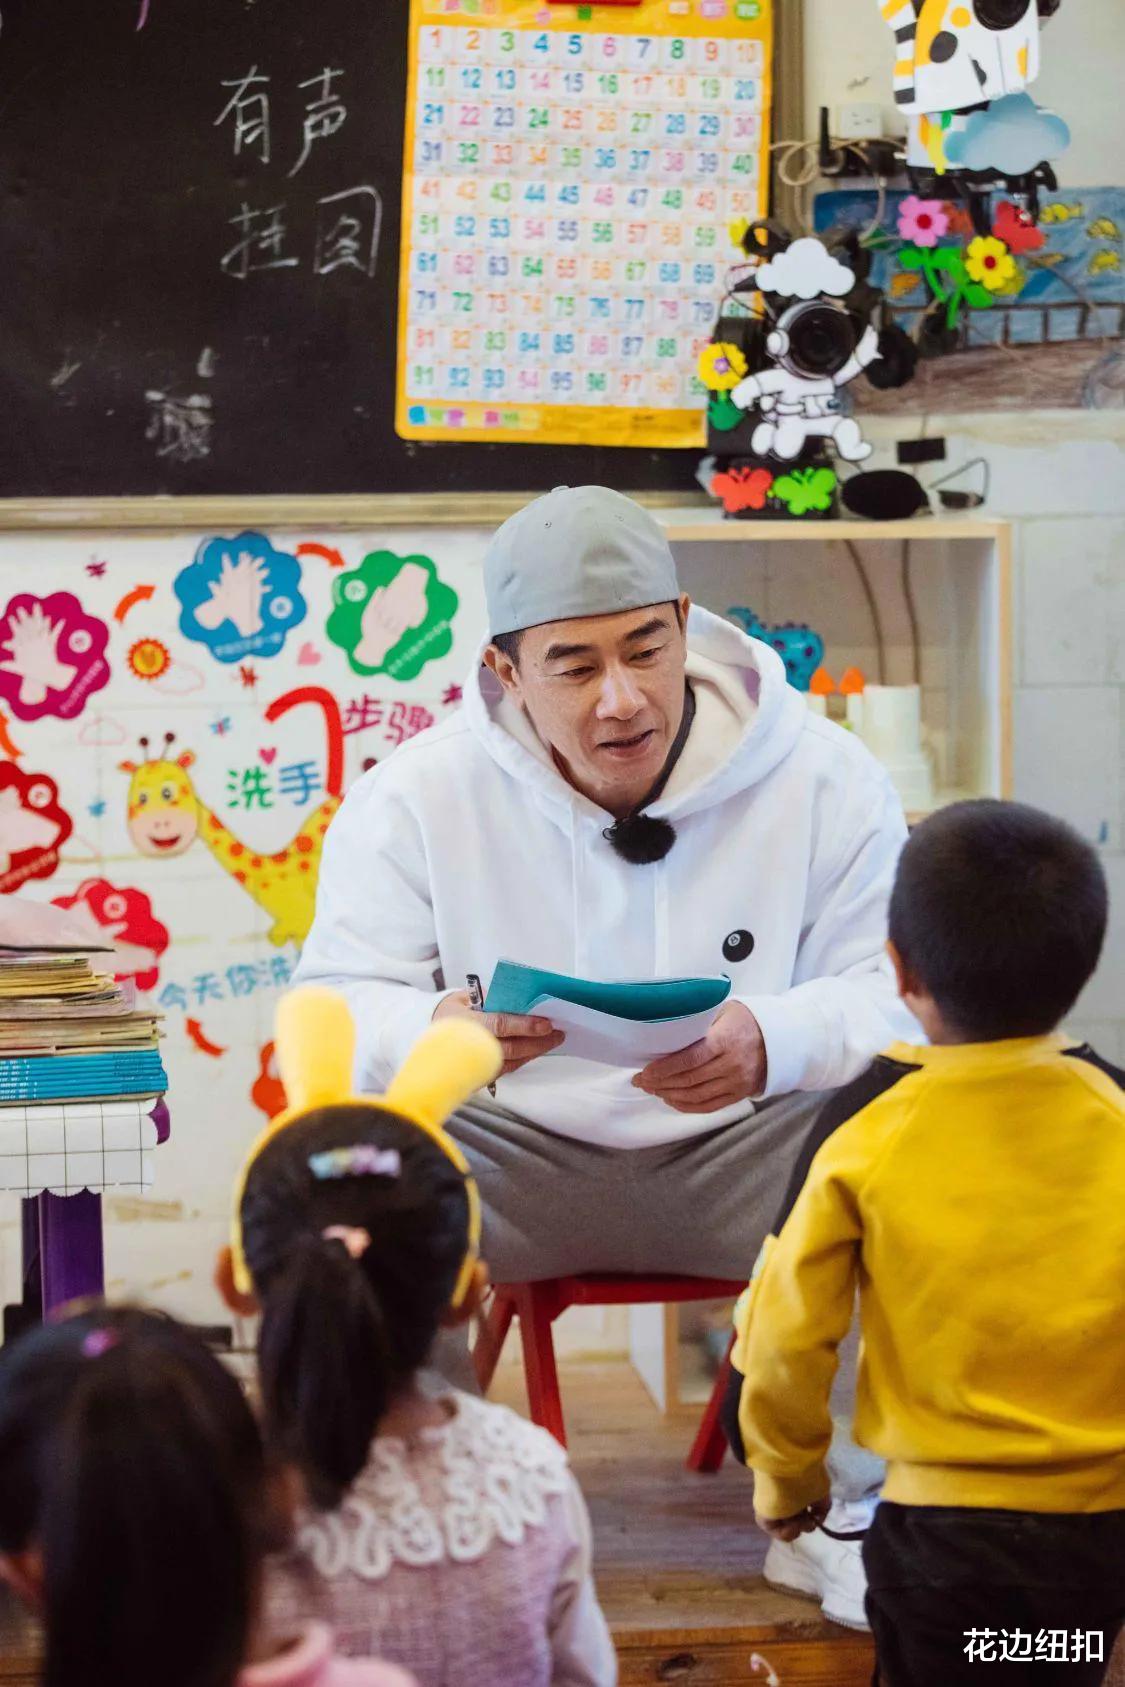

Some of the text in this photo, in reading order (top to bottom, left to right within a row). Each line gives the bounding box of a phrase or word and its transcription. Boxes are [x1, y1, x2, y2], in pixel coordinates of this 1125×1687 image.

[431, 29, 755, 64] 1 2 3 4 5 6 7 8 9 10
[426, 68, 755, 100] 11 12 13 14 15 16 17 18 19 20
[213, 65, 347, 178] 有声
[424, 104, 443, 124] 21
[459, 106, 480, 126] 22
[494, 107, 514, 127] 23
[529, 108, 549, 128] 24
[563, 110, 582, 129] 25
[631, 112, 653, 133] 27
[666, 114, 685, 134] 28
[699, 115, 720, 136] 29
[734, 117, 754, 137] 30
[422, 141, 442, 161] 31
[459, 143, 478, 163] 32
[493, 144, 514, 165] 33
[563, 148, 581, 167] 35
[595, 149, 616, 168] 36
[630, 150, 651, 170] 37
[664, 152, 684, 172] 38
[698, 153, 718, 173] 39
[732, 154, 753, 174] 40
[420, 180, 440, 196] 41
[456, 181, 478, 200] 42
[490, 181, 511, 203] 43
[524, 185, 545, 201] 44
[558, 186, 579, 204] 45
[628, 189, 648, 205] 47
[662, 190, 682, 209] 48
[696, 191, 716, 211] 49
[732, 192, 750, 212] 50
[220, 185, 382, 279] 挂图
[420, 215, 439, 234] 51
[455, 216, 475, 236] 52
[489, 218, 510, 238] 53
[525, 219, 545, 239] 54
[592, 223, 612, 242] 56
[628, 223, 648, 243] 57
[662, 224, 682, 245] 58
[694, 224, 716, 247] 59
[418, 252, 437, 272] 61
[489, 256, 509, 276] 63
[524, 257, 543, 276] 64
[626, 260, 646, 280] 67
[660, 263, 680, 283] 68
[694, 264, 714, 284] 69
[417, 290, 436, 308] 71
[452, 291, 472, 311] 72
[488, 292, 508, 313] 73
[522, 294, 543, 313] 74
[556, 294, 576, 315] 75
[589, 297, 610, 317] 76
[624, 298, 644, 319] 77
[660, 300, 679, 320] 78
[693, 301, 714, 322] 79
[485, 331, 506, 351] 83
[520, 333, 540, 352] 84
[554, 334, 574, 354] 85
[622, 336, 643, 355] 87
[449, 367, 469, 387] 92
[484, 368, 504, 389] 93
[518, 371, 539, 389] 94
[551, 372, 572, 391] 95
[620, 374, 643, 392] 97
[227, 765, 321, 810] 洗手
[158, 952, 300, 1011] 今天你洗
